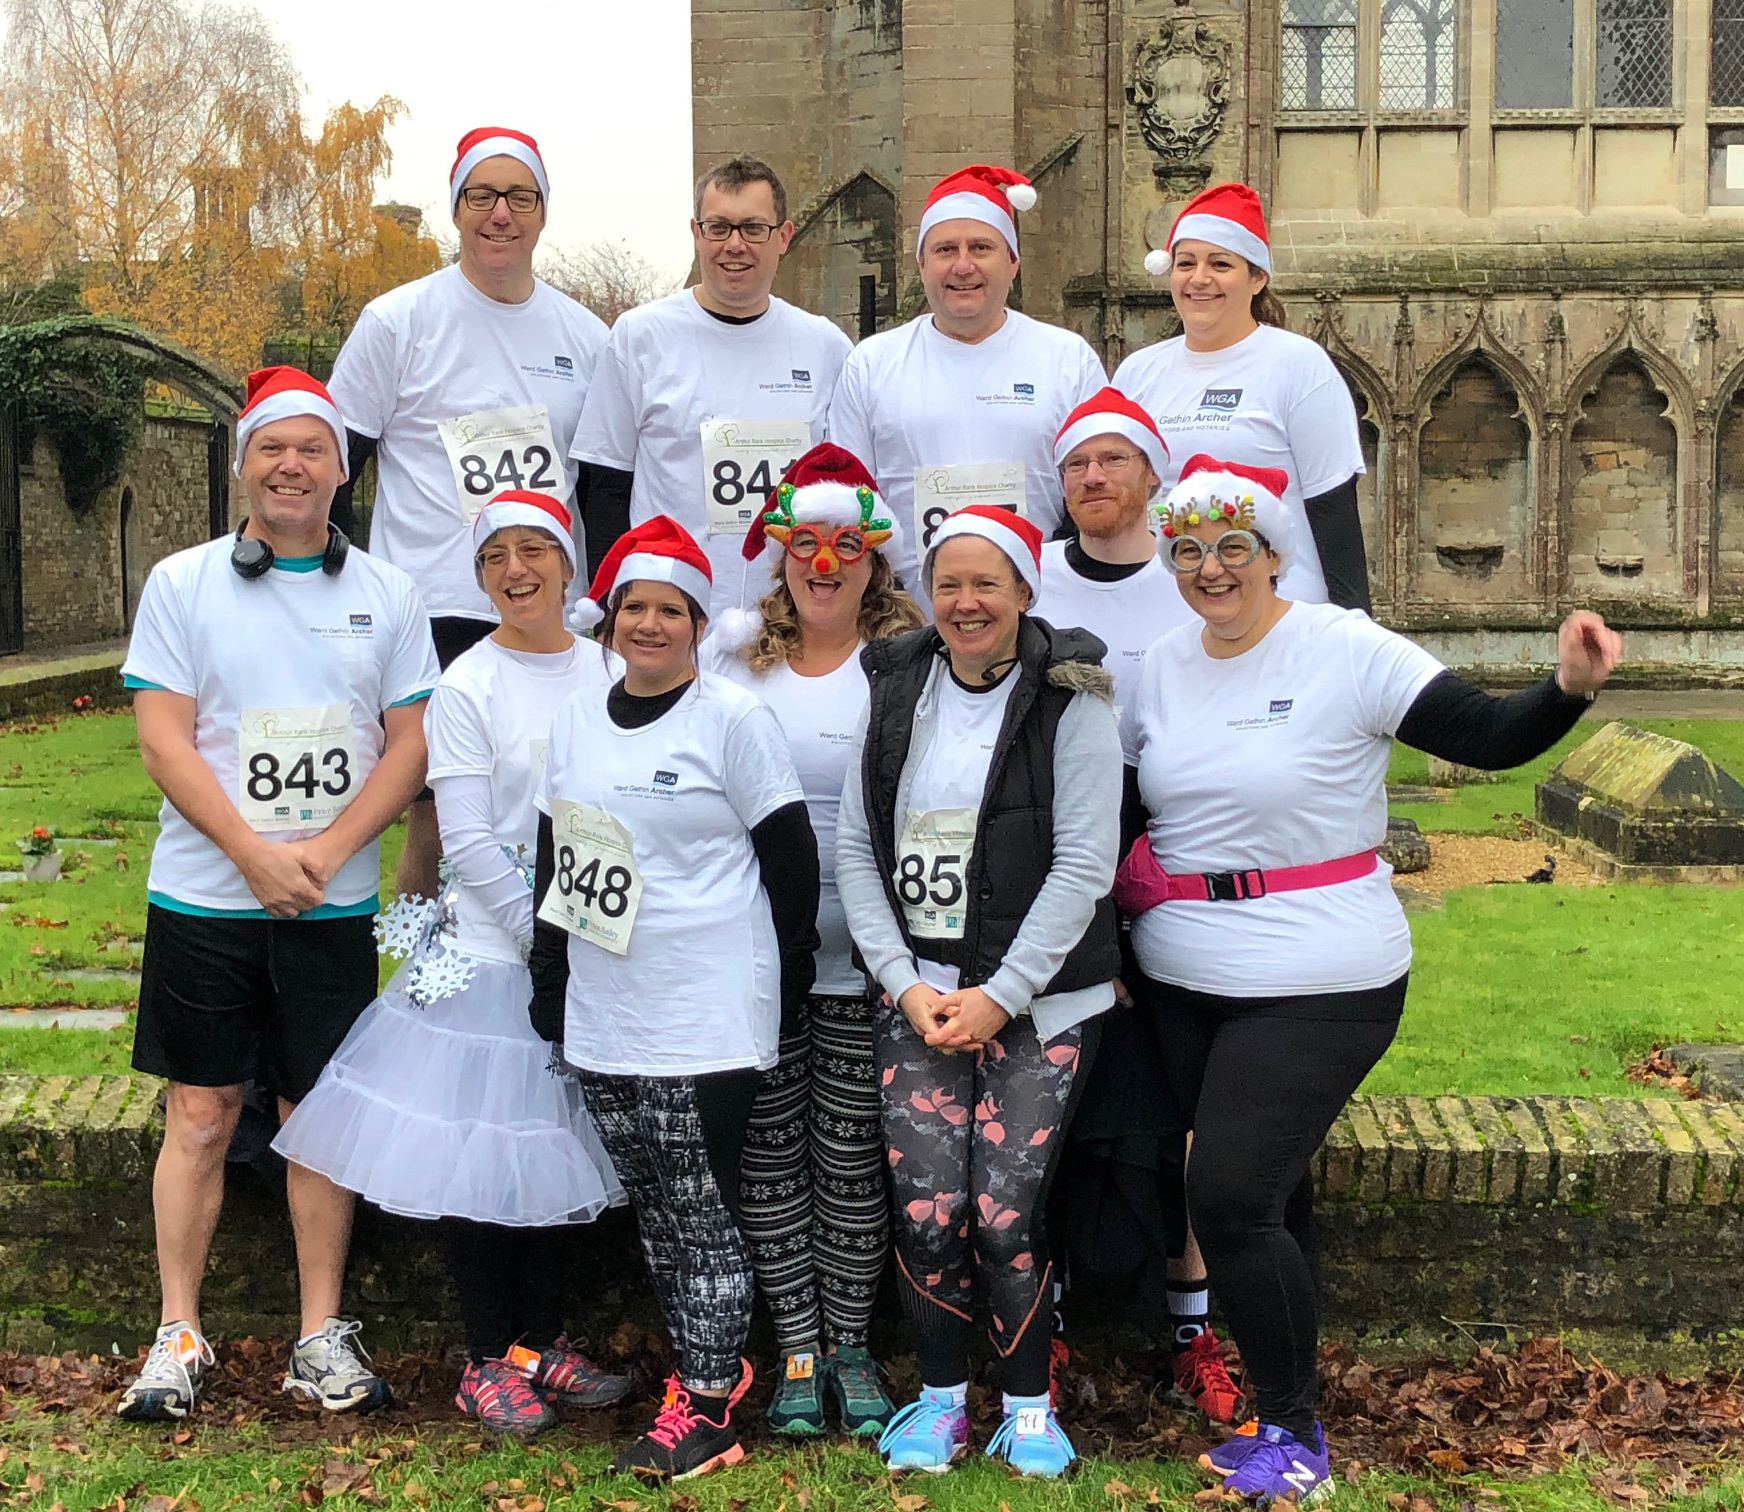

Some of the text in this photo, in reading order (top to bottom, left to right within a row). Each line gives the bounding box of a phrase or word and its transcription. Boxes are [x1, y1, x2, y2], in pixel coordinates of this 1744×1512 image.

[1205, 393, 1238, 405] WGA
[1159, 415, 1191, 425] Gethin
[1193, 413, 1233, 423] Archer
[459, 445, 558, 496] 842
[713, 459, 797, 506] 84
[351, 616, 371, 624] WGA
[1271, 702, 1291, 711] WGA
[819, 731, 838, 740] Ward
[247, 747, 352, 802] 843
[655, 773, 676, 783] WGA
[651, 787, 675, 796] Archer
[558, 845, 632, 918] 848
